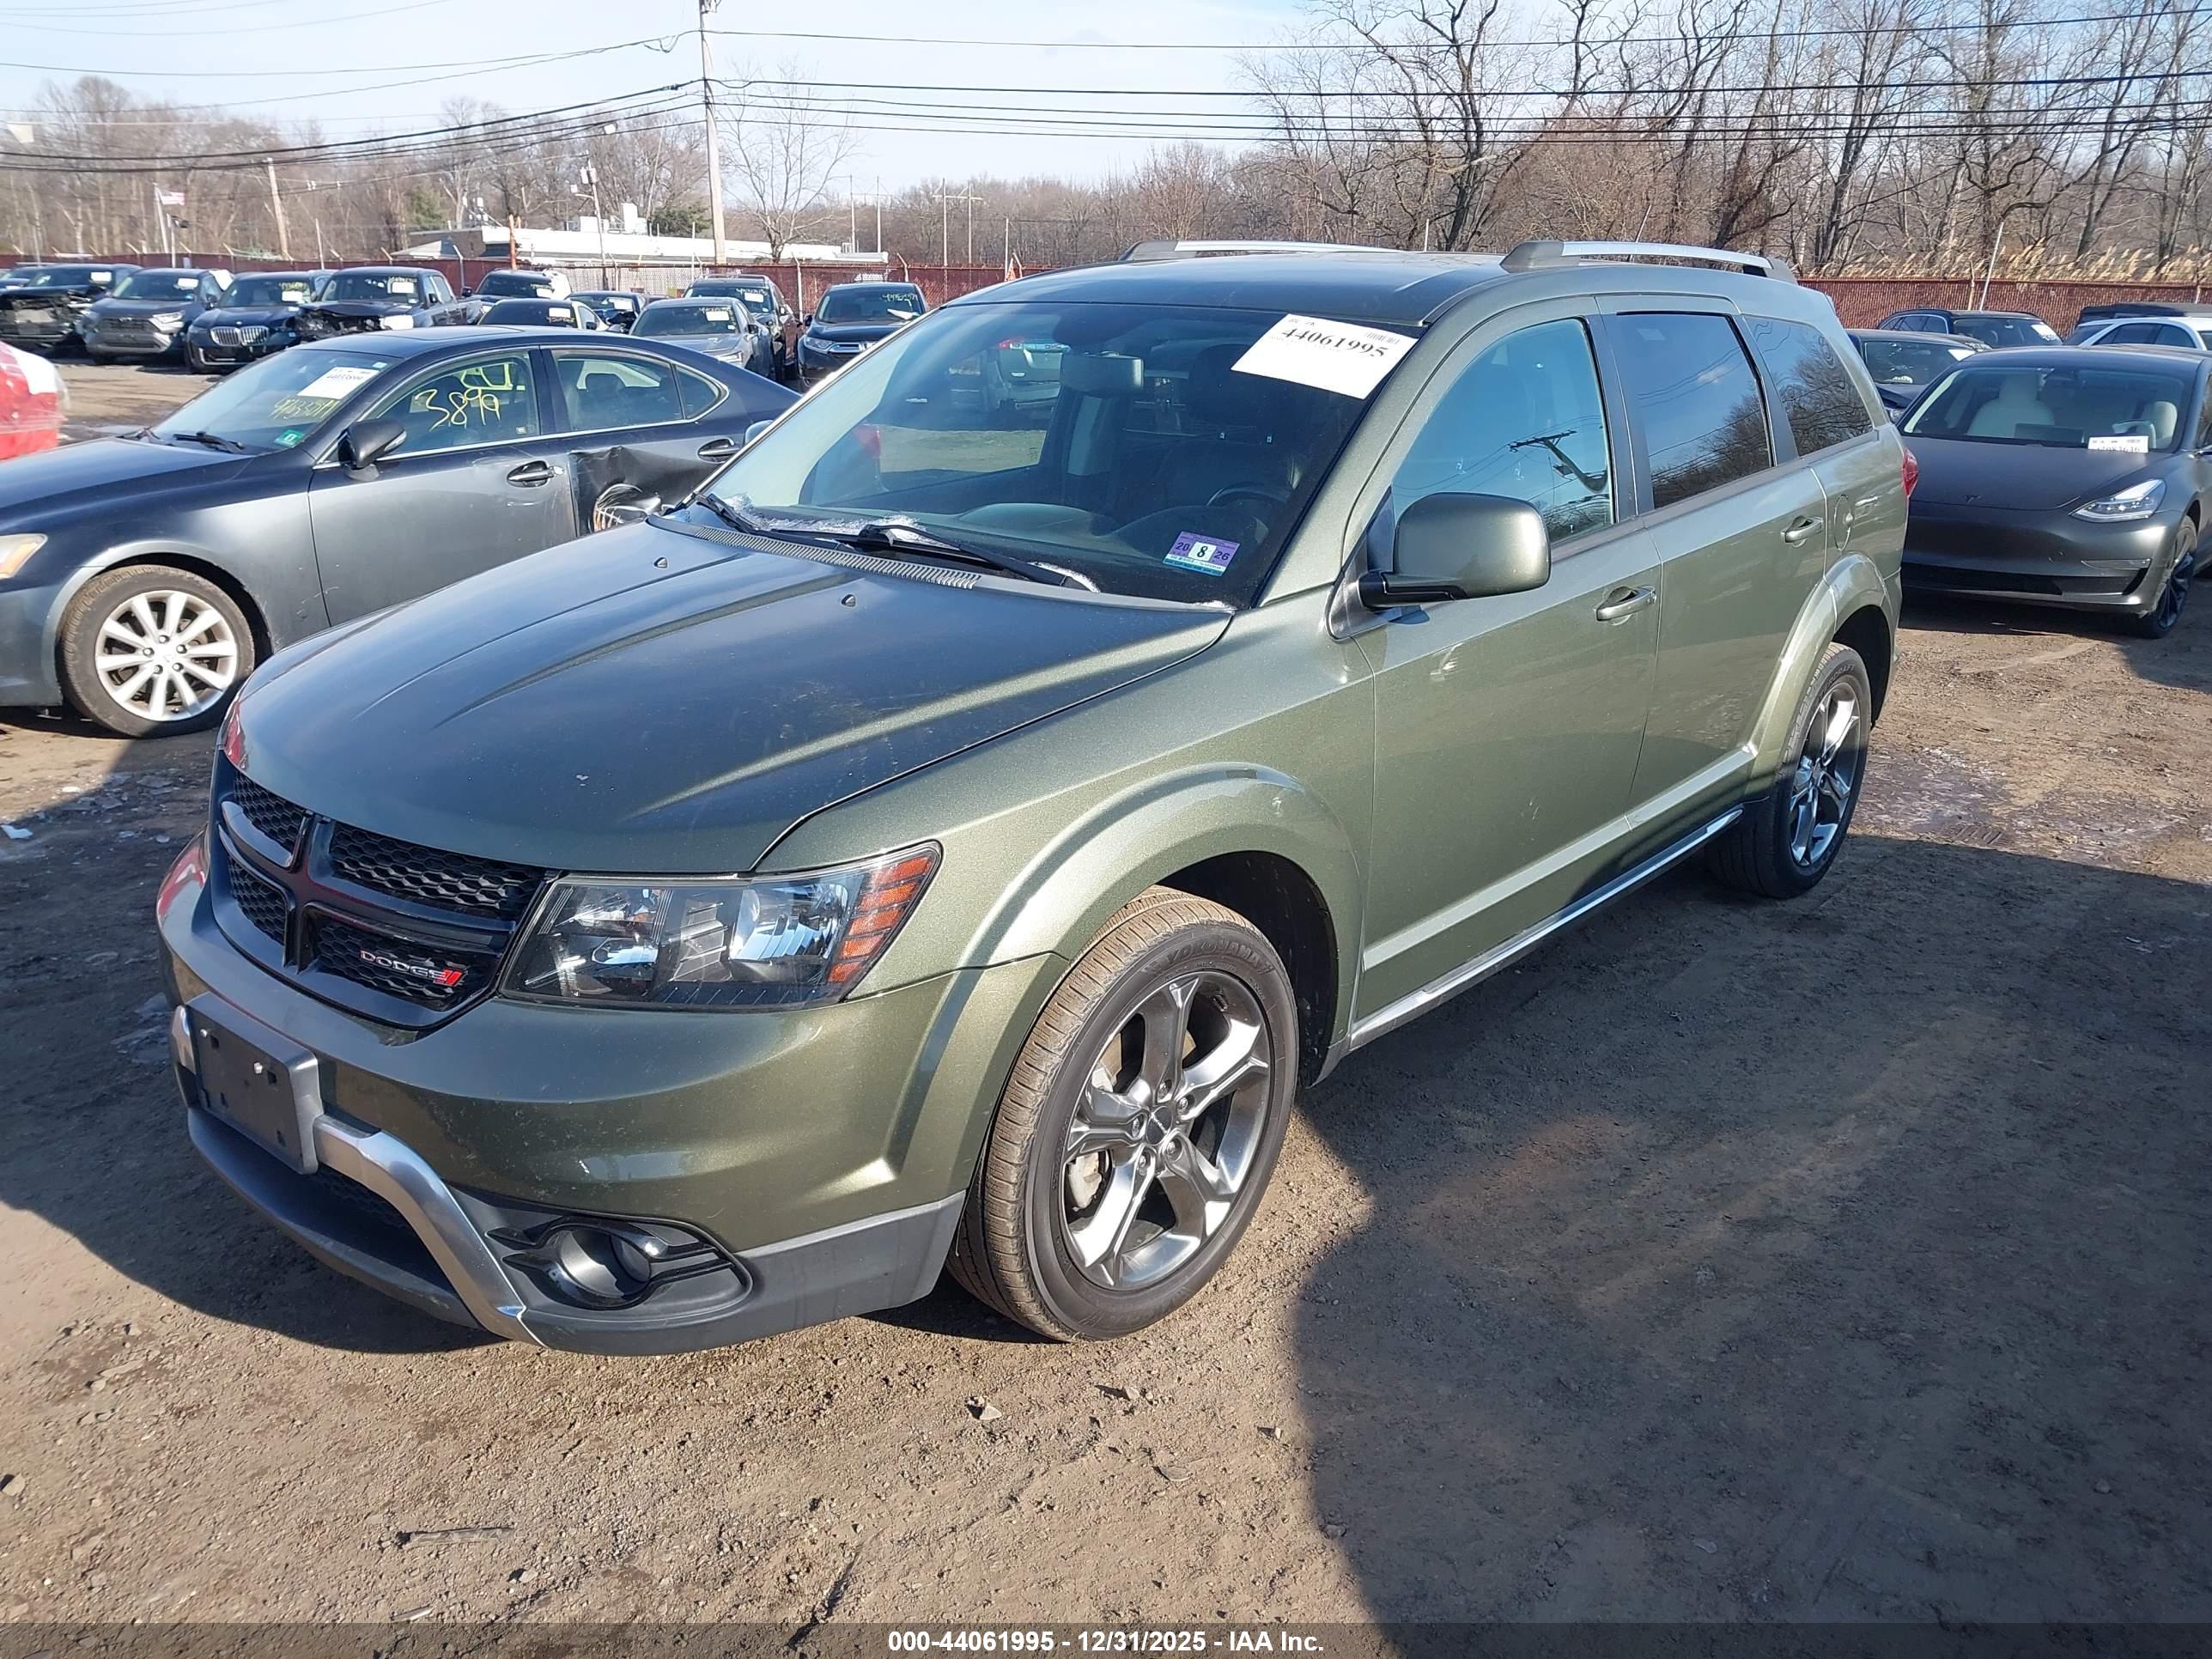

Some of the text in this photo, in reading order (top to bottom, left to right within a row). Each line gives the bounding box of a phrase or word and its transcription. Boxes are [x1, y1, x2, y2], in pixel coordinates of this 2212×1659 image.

[1280, 327, 1389, 357] 44061995
[414, 387, 501, 433] 3899
[1175, 542, 1231, 561] 20 8 26
[360, 950, 448, 981] DODGE
